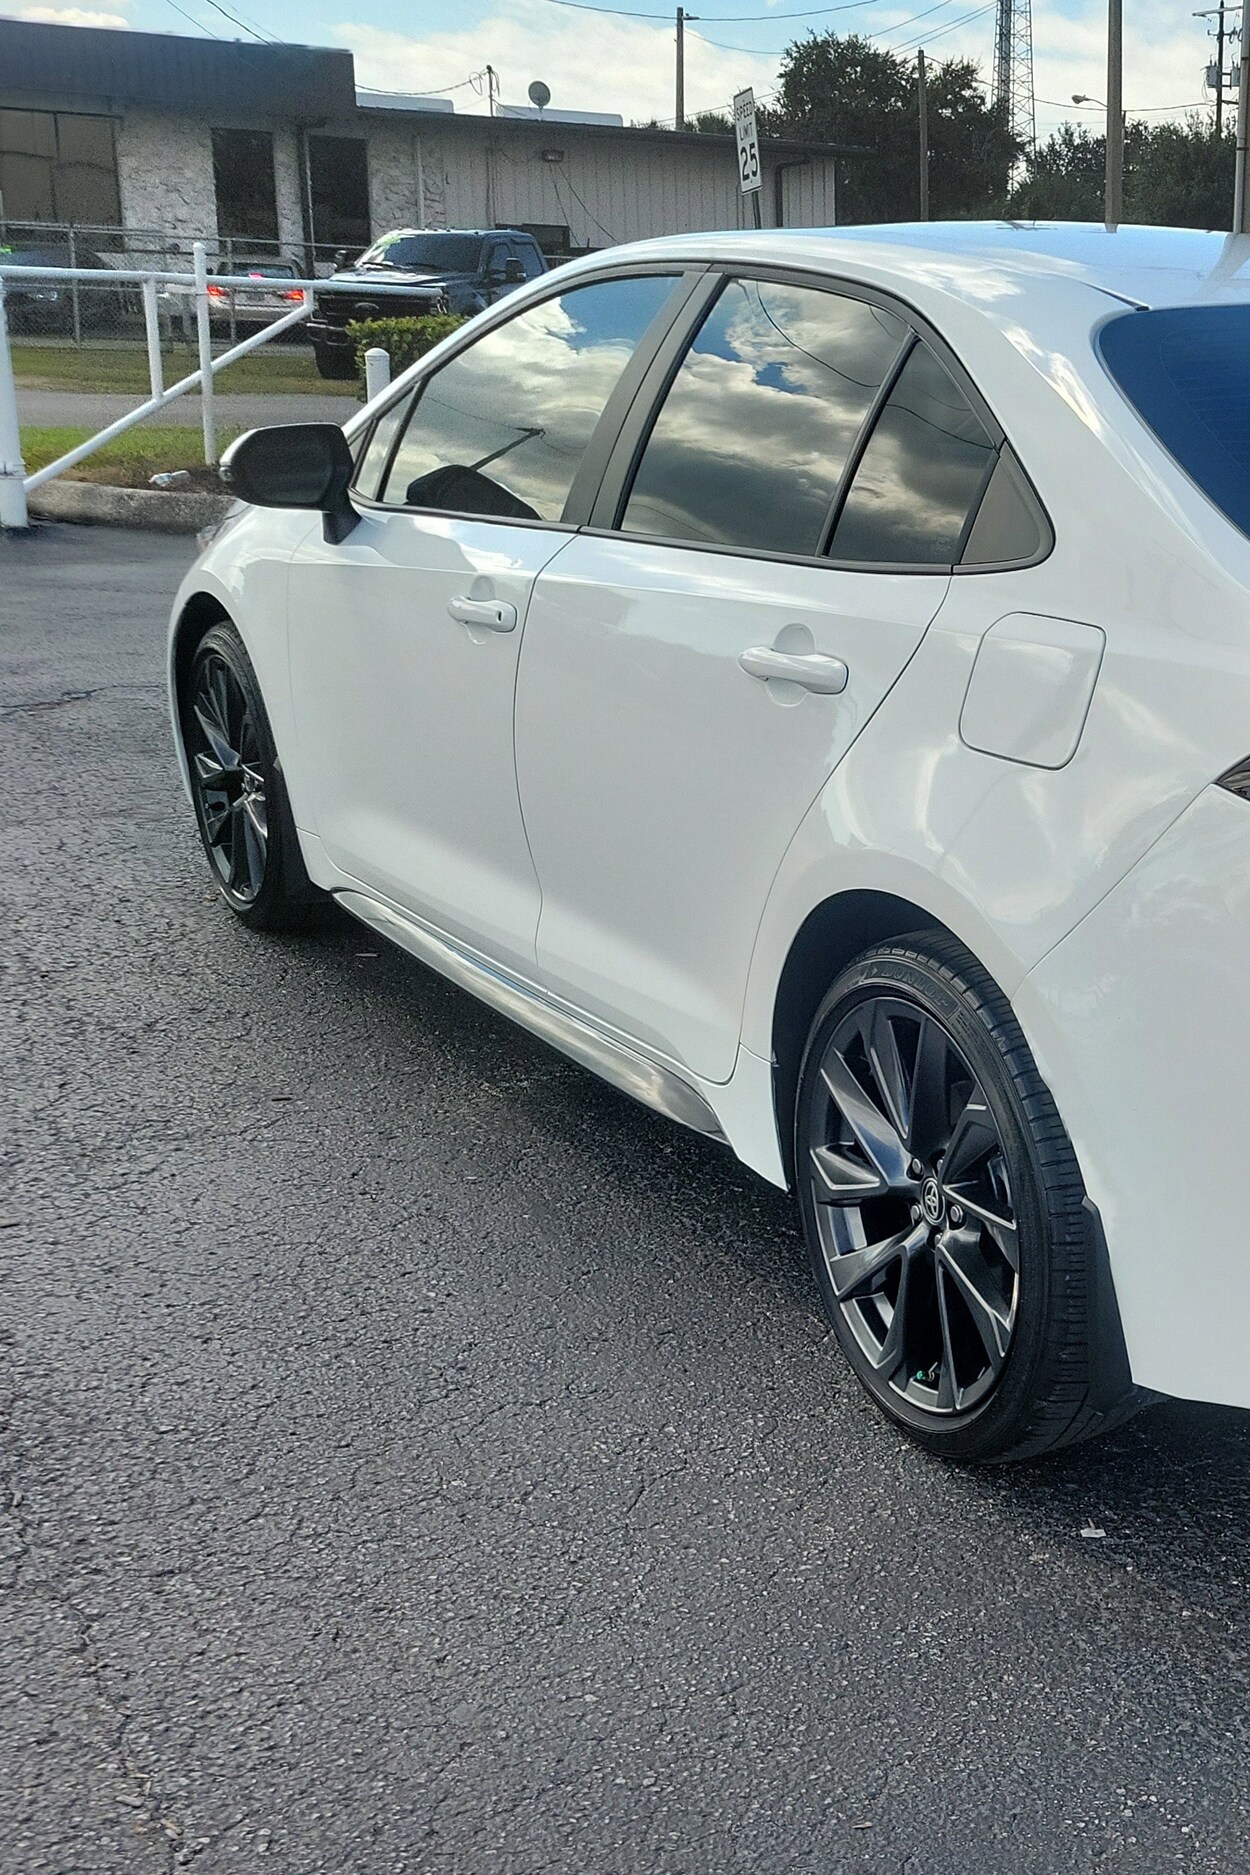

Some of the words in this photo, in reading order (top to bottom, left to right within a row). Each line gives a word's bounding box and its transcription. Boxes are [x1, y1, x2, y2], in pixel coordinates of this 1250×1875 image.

[736, 101, 753, 121] SPEED
[739, 121, 753, 141] LIMIT
[740, 142, 758, 181] 25
